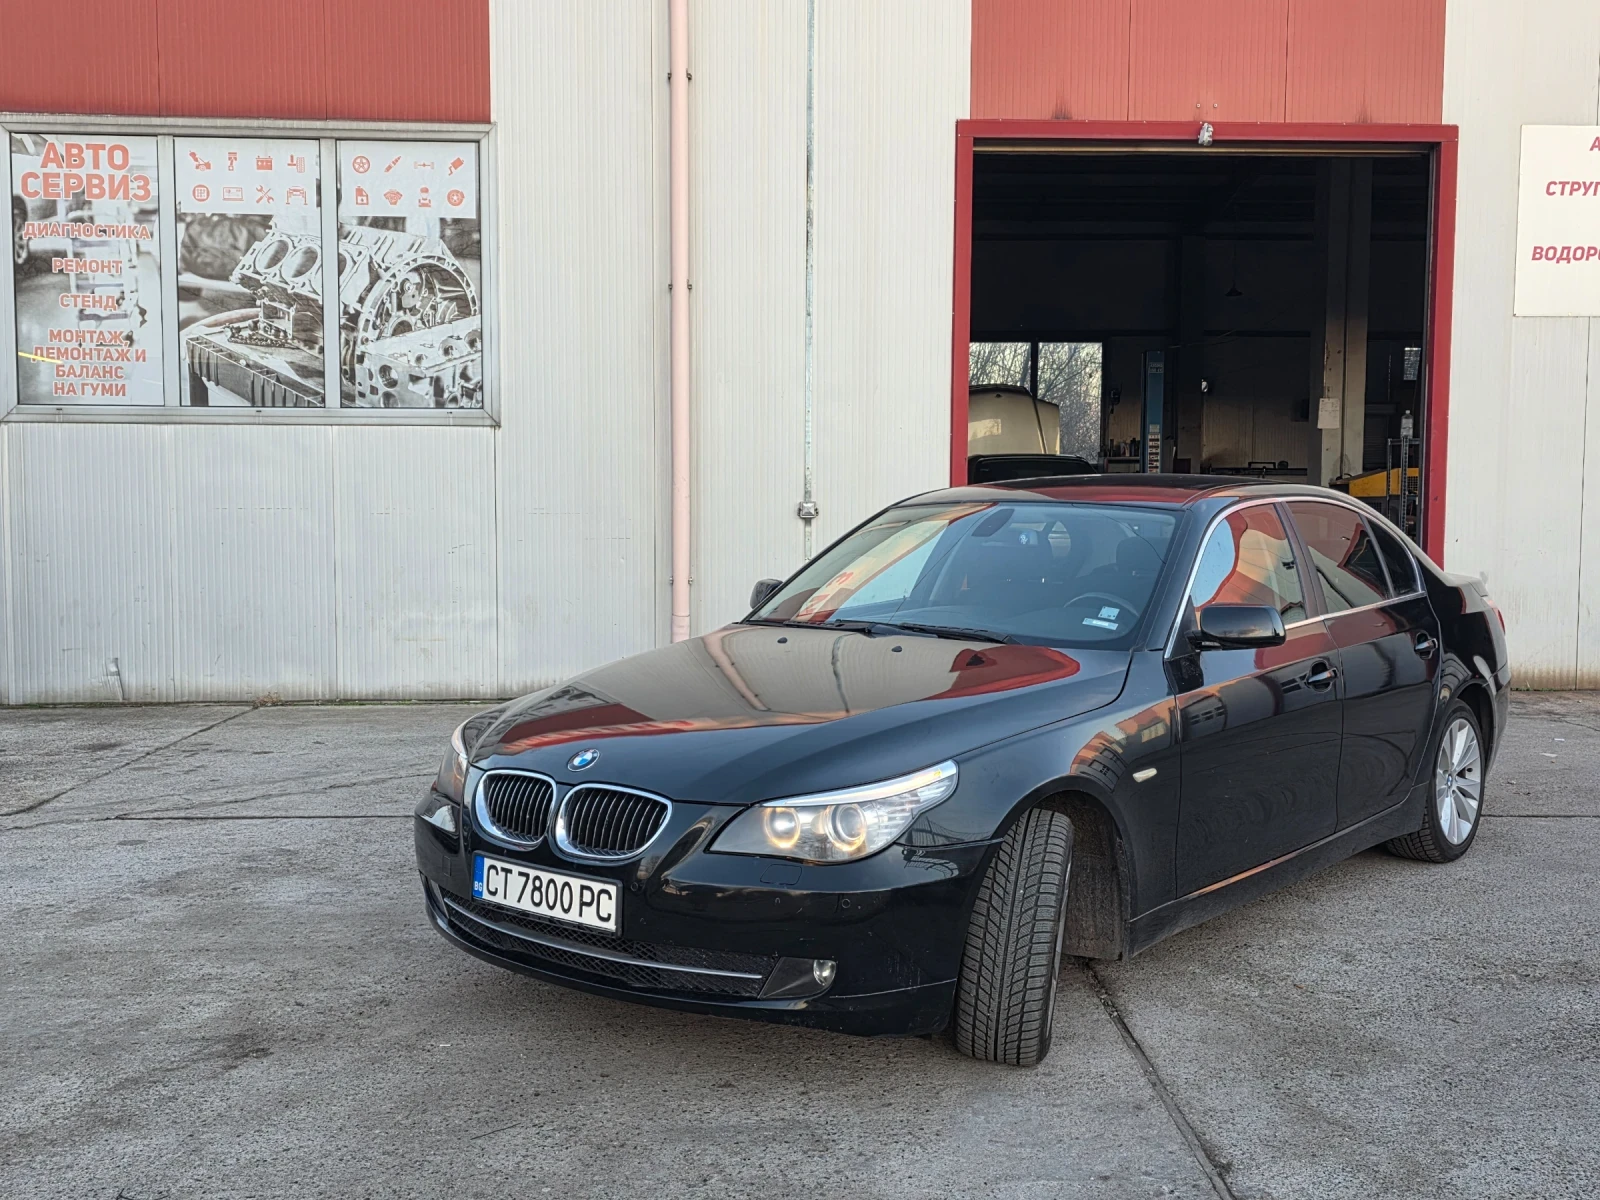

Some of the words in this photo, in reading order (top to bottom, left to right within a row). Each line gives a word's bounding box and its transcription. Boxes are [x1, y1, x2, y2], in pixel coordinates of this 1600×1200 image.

[40, 142, 130, 171] АВТО
[20, 171, 152, 201] СЕРВИЗ
[23, 222, 151, 239] ДИАГНОСТИКА
[1531, 245, 1600, 264] ВОДОР
[52, 258, 122, 274] РЕМОНТ
[59, 294, 117, 311] СТЕНД
[49, 329, 130, 346] МОНТАЖ,
[31, 346, 130, 363] ДЕМОНТАЖ
[135, 348, 146, 363] И
[55, 364, 125, 379] БАЛАНС
[53, 381, 77, 396] НА
[81, 383, 126, 397] ГУМИ
[474, 881, 483, 892] BG
